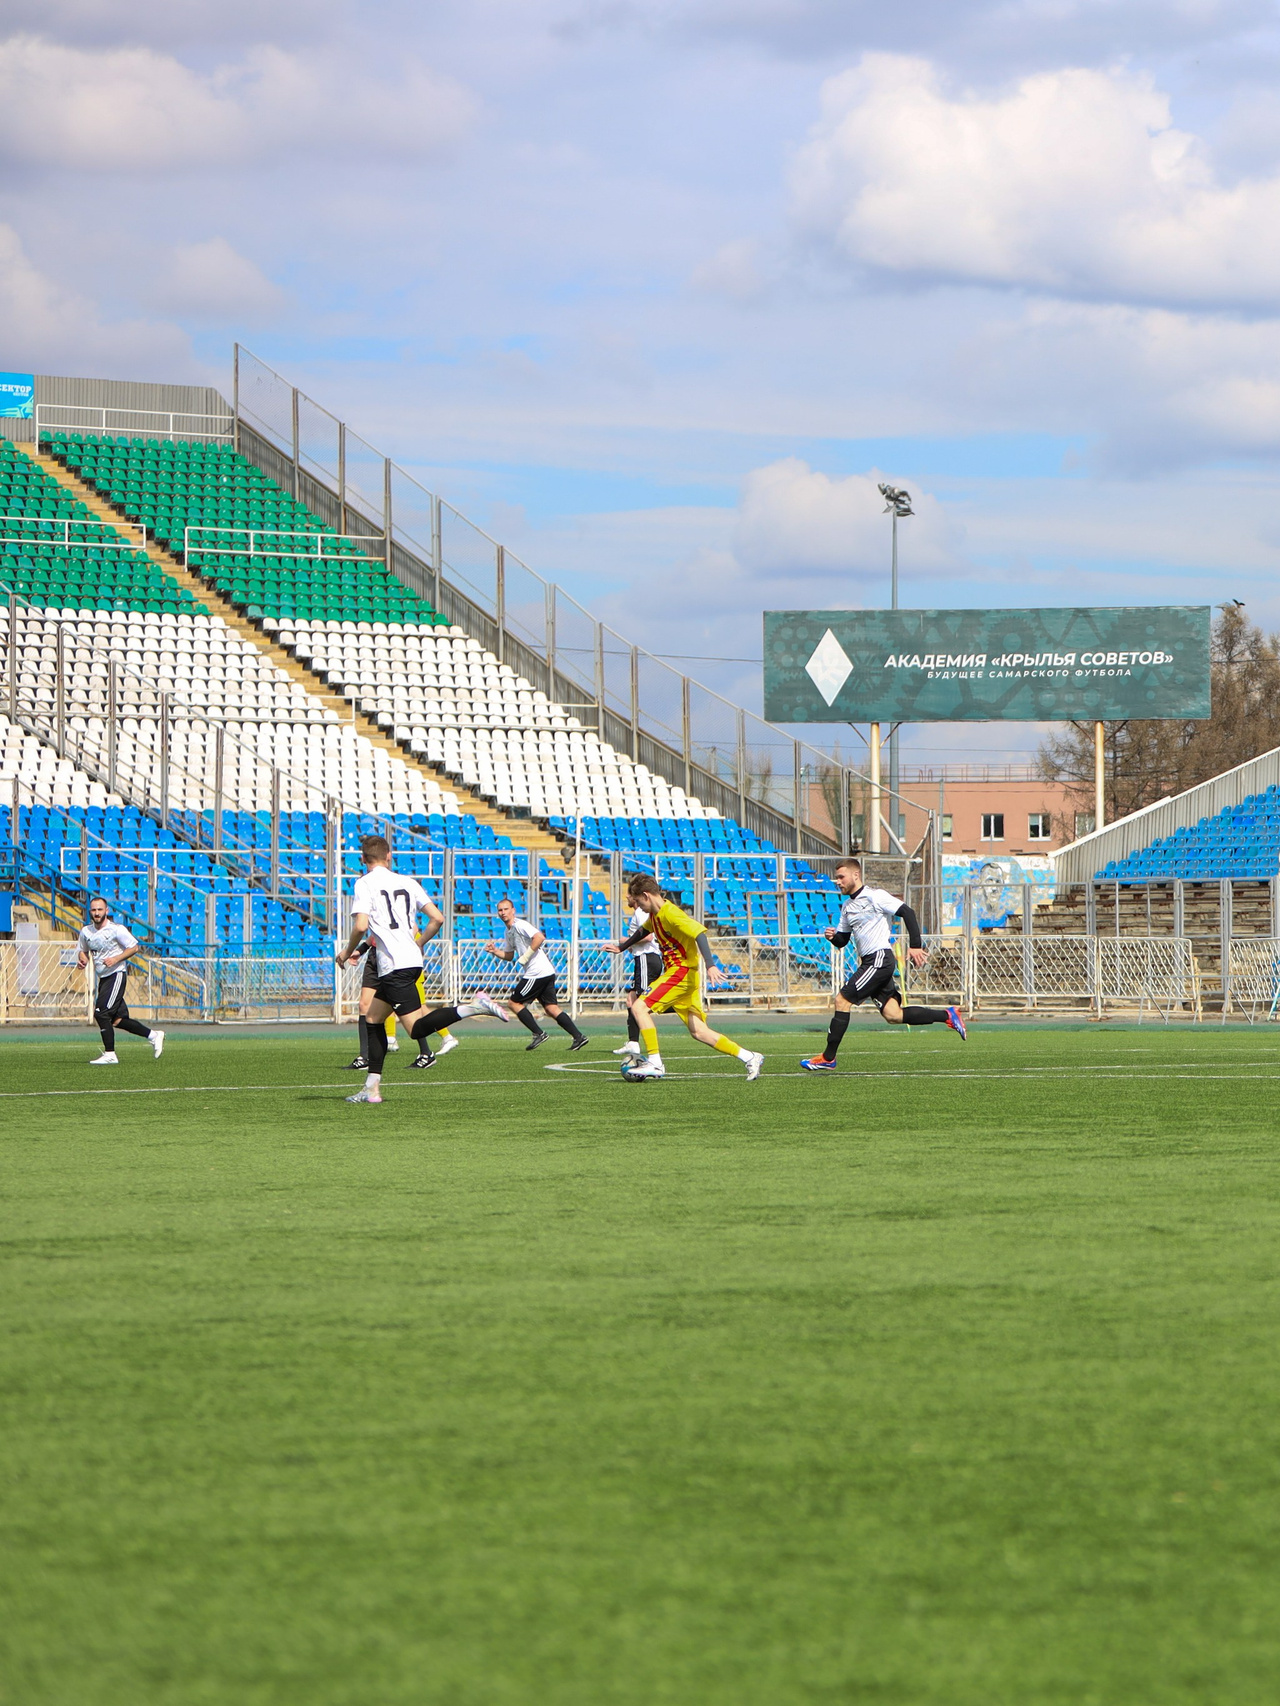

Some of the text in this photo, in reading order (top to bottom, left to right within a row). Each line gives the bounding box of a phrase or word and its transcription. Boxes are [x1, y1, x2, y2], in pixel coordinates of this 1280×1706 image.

[884, 651, 1174, 669] АКАДЕМИЯ «КРЫЛЬЯ СОВЕТОВ»
[927, 668, 1132, 680] БУДУЩЕЕ САМАРСКОГО ФУТБОЛА
[380, 888, 412, 929] 17
